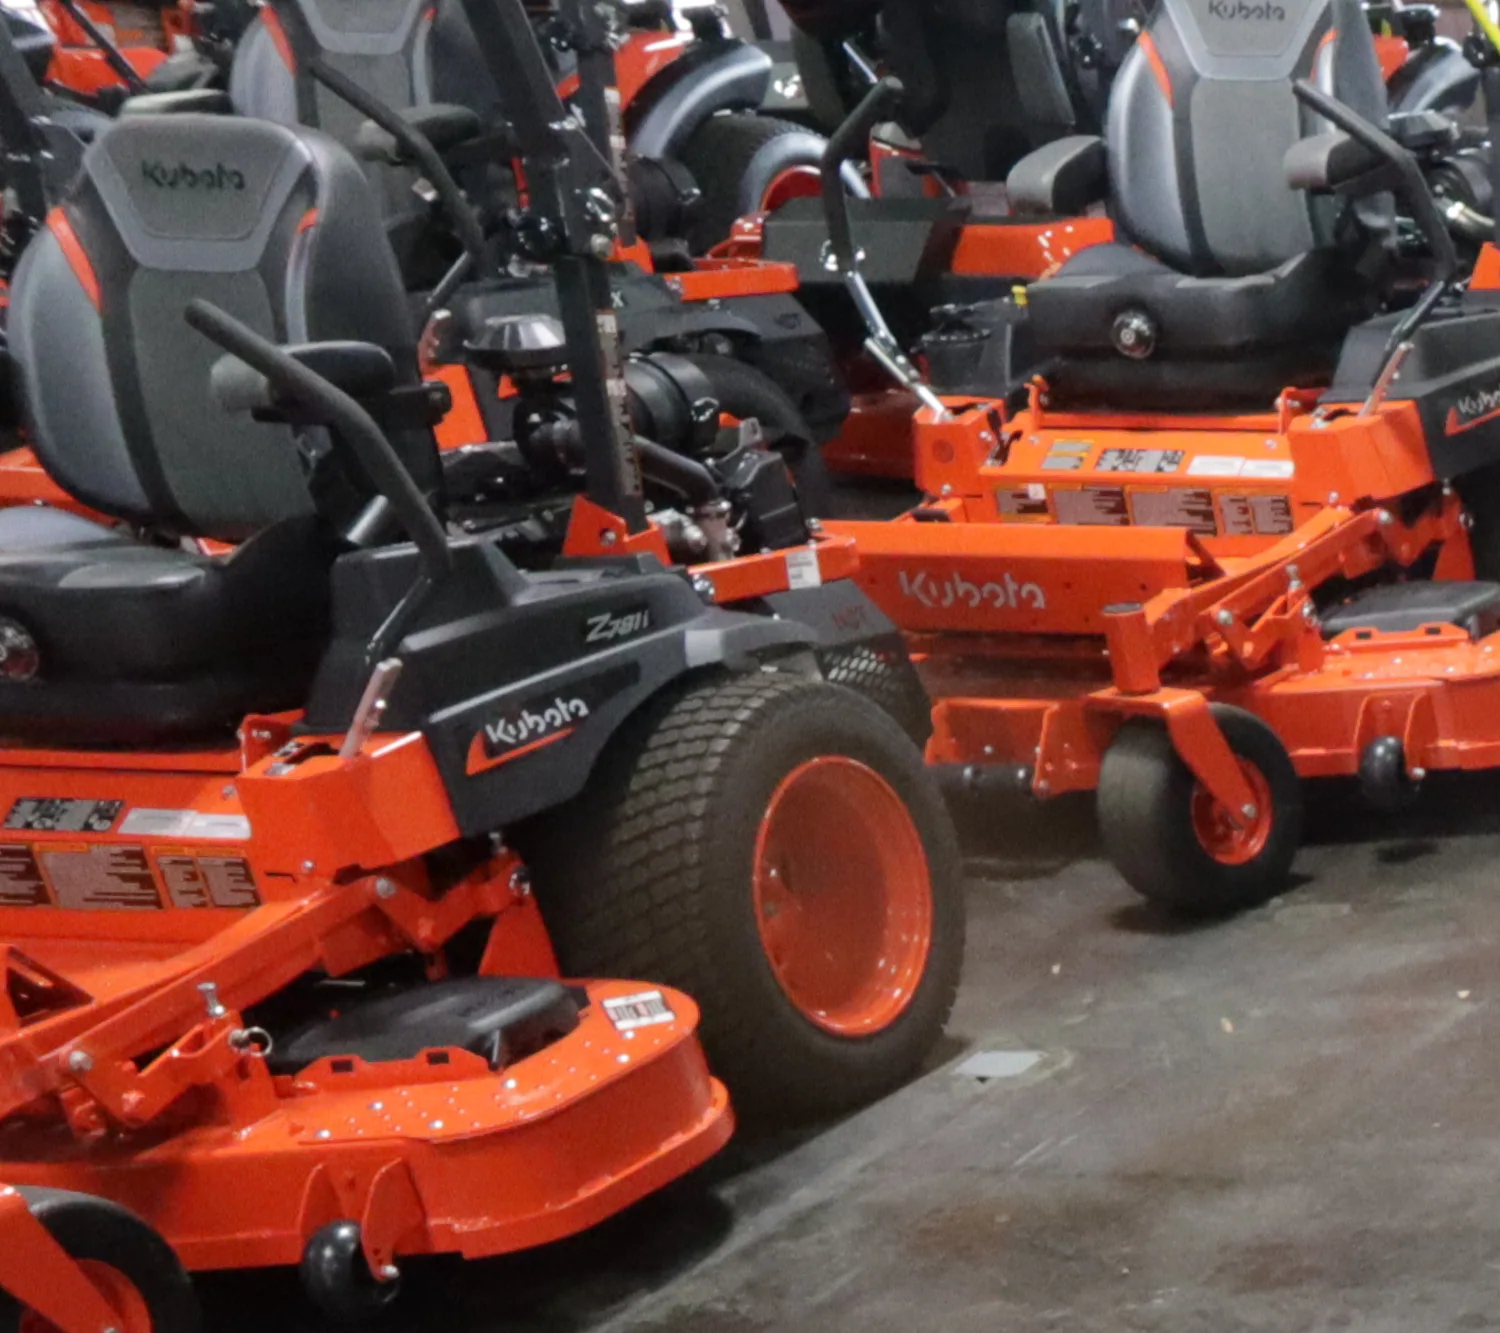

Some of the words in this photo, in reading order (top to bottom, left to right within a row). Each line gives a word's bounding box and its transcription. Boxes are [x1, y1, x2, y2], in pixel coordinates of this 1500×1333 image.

[1208, 0, 1285, 20] Kubota
[142, 160, 245, 190] Kubota
[899, 570, 1046, 609] Kubota
[485, 697, 589, 743] Kubota
